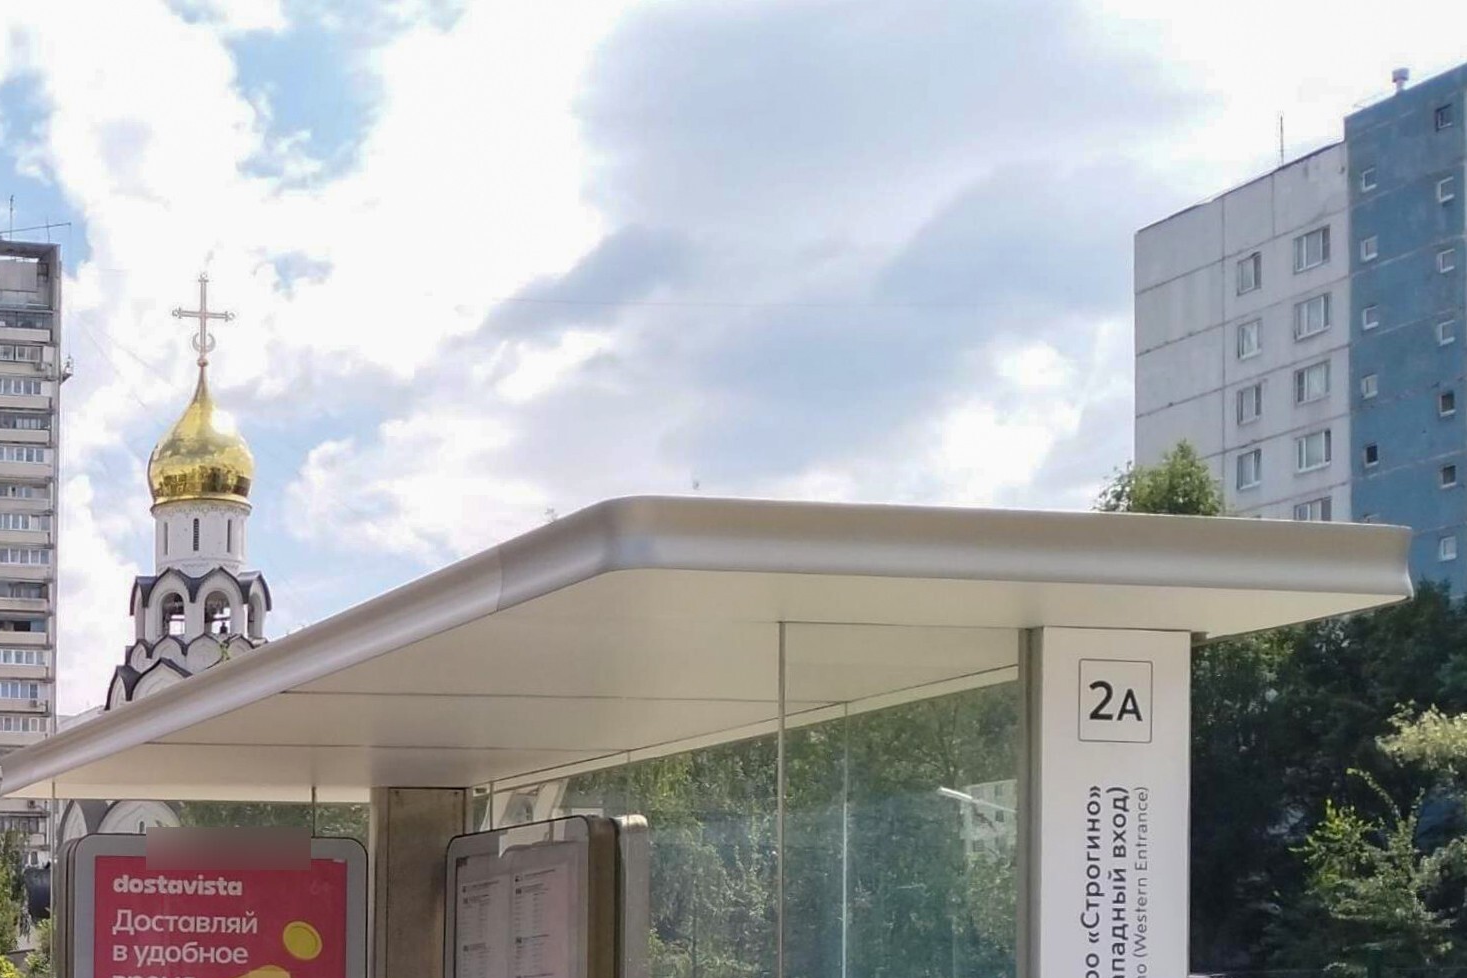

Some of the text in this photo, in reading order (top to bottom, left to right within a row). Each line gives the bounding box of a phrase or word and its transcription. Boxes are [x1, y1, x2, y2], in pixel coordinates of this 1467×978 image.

[1089, 680, 1143, 721] 2А
[1105, 786, 1130, 858] вход)
[1133, 785, 1149, 871] Entrance)
[113, 874, 243, 896] dostavista
[1080, 785, 1105, 944] «Строгино»
[112, 908, 258, 936] Доставляй
[1133, 877, 1148, 958] (Western
[112, 941, 249, 968] в удобное
